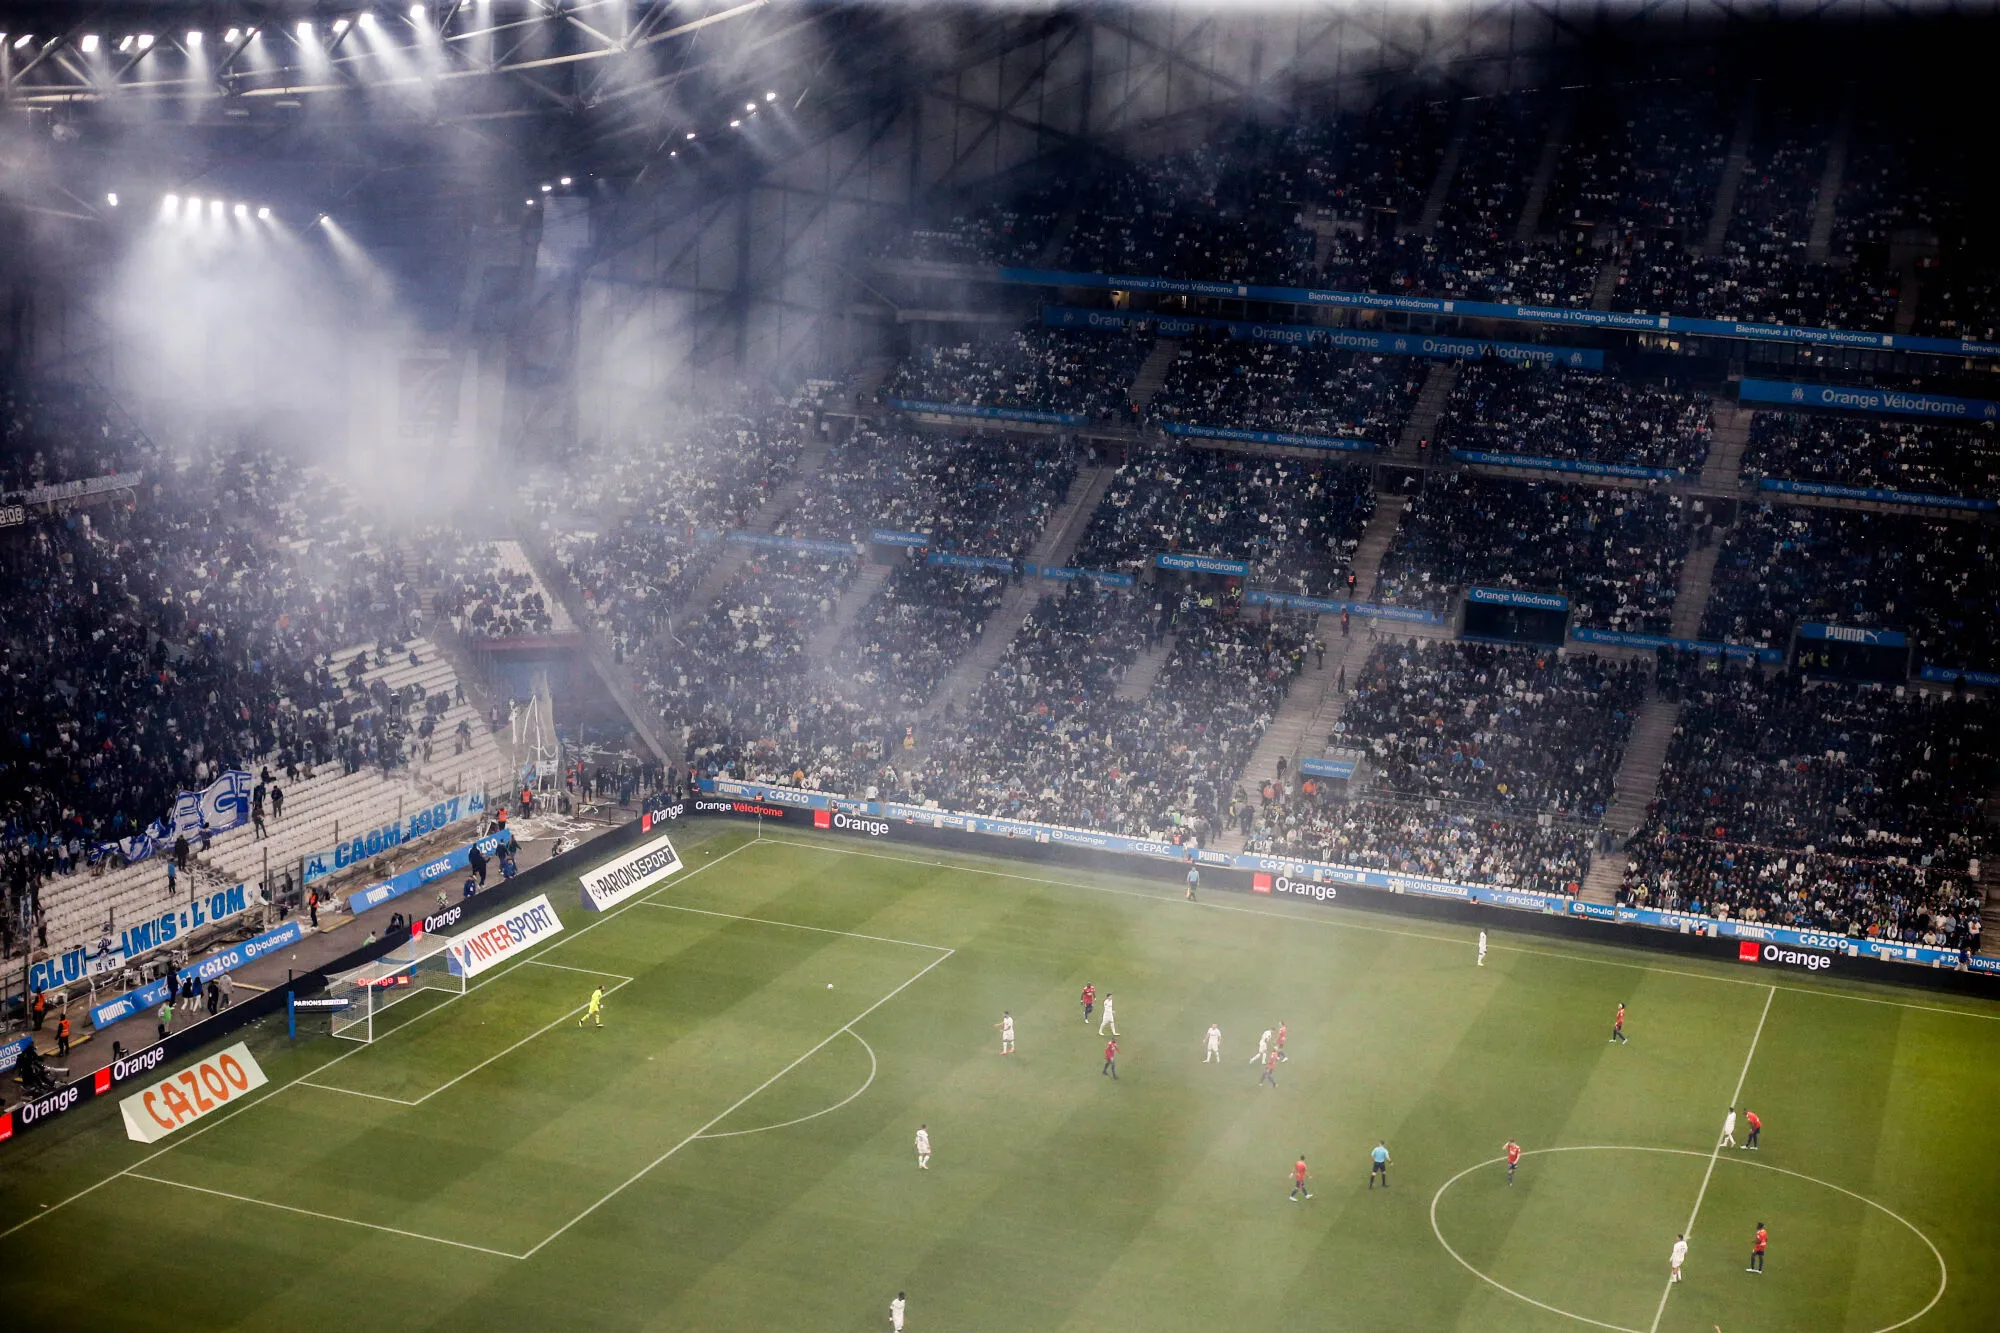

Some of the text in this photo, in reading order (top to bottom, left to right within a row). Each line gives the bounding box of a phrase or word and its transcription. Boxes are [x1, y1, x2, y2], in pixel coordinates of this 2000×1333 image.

[1108, 277, 1149, 287] Bienvenue
[1308, 292, 1350, 302] Bienvenue
[1517, 308, 1561, 319] Bienvenue
[1252, 326, 1302, 342] Orange
[1735, 324, 1781, 336] Bienvenue
[1422, 339, 1474, 356] Orange
[1821, 389, 1966, 415] Orange Vélodrome
[1162, 556, 1244, 573] Orange Vélodrome
[1475, 589, 1561, 608] Orange Vélodrome
[1825, 626, 1865, 642] PUMA
[718, 783, 809, 804] PUMA CAZOO
[652, 803, 684, 825] Orange
[695, 801, 784, 817] Orange Vélodrome
[334, 797, 460, 869] CAOM 1987
[834, 813, 889, 836] Orange
[1064, 832, 1107, 846] boulanger
[1135, 842, 1170, 855] CEPAC
[1198, 850, 1225, 862] PUMA
[426, 858, 452, 878] CEPAC
[597, 848, 674, 898] PARIONS SPORT
[1324, 869, 1354, 880] Orange
[366, 885, 389, 904] PUMA
[1275, 877, 1337, 901] Orange
[1506, 895, 1545, 908] randstad
[424, 906, 461, 934] Orange
[467, 903, 553, 963] INTERSPORT
[1735, 925, 1765, 938] PUMA
[1800, 934, 1849, 949] CAZOO
[1763, 944, 1831, 971] Orange
[29, 947, 87, 994] CLU
[98, 1001, 126, 1024] PUMA
[199, 952, 239, 978] CAZOO
[255, 928, 295, 951] boulanger
[113, 1047, 164, 1082] Orange
[142, 1053, 249, 1130] CAZOO
[22, 1087, 78, 1125] Orange
